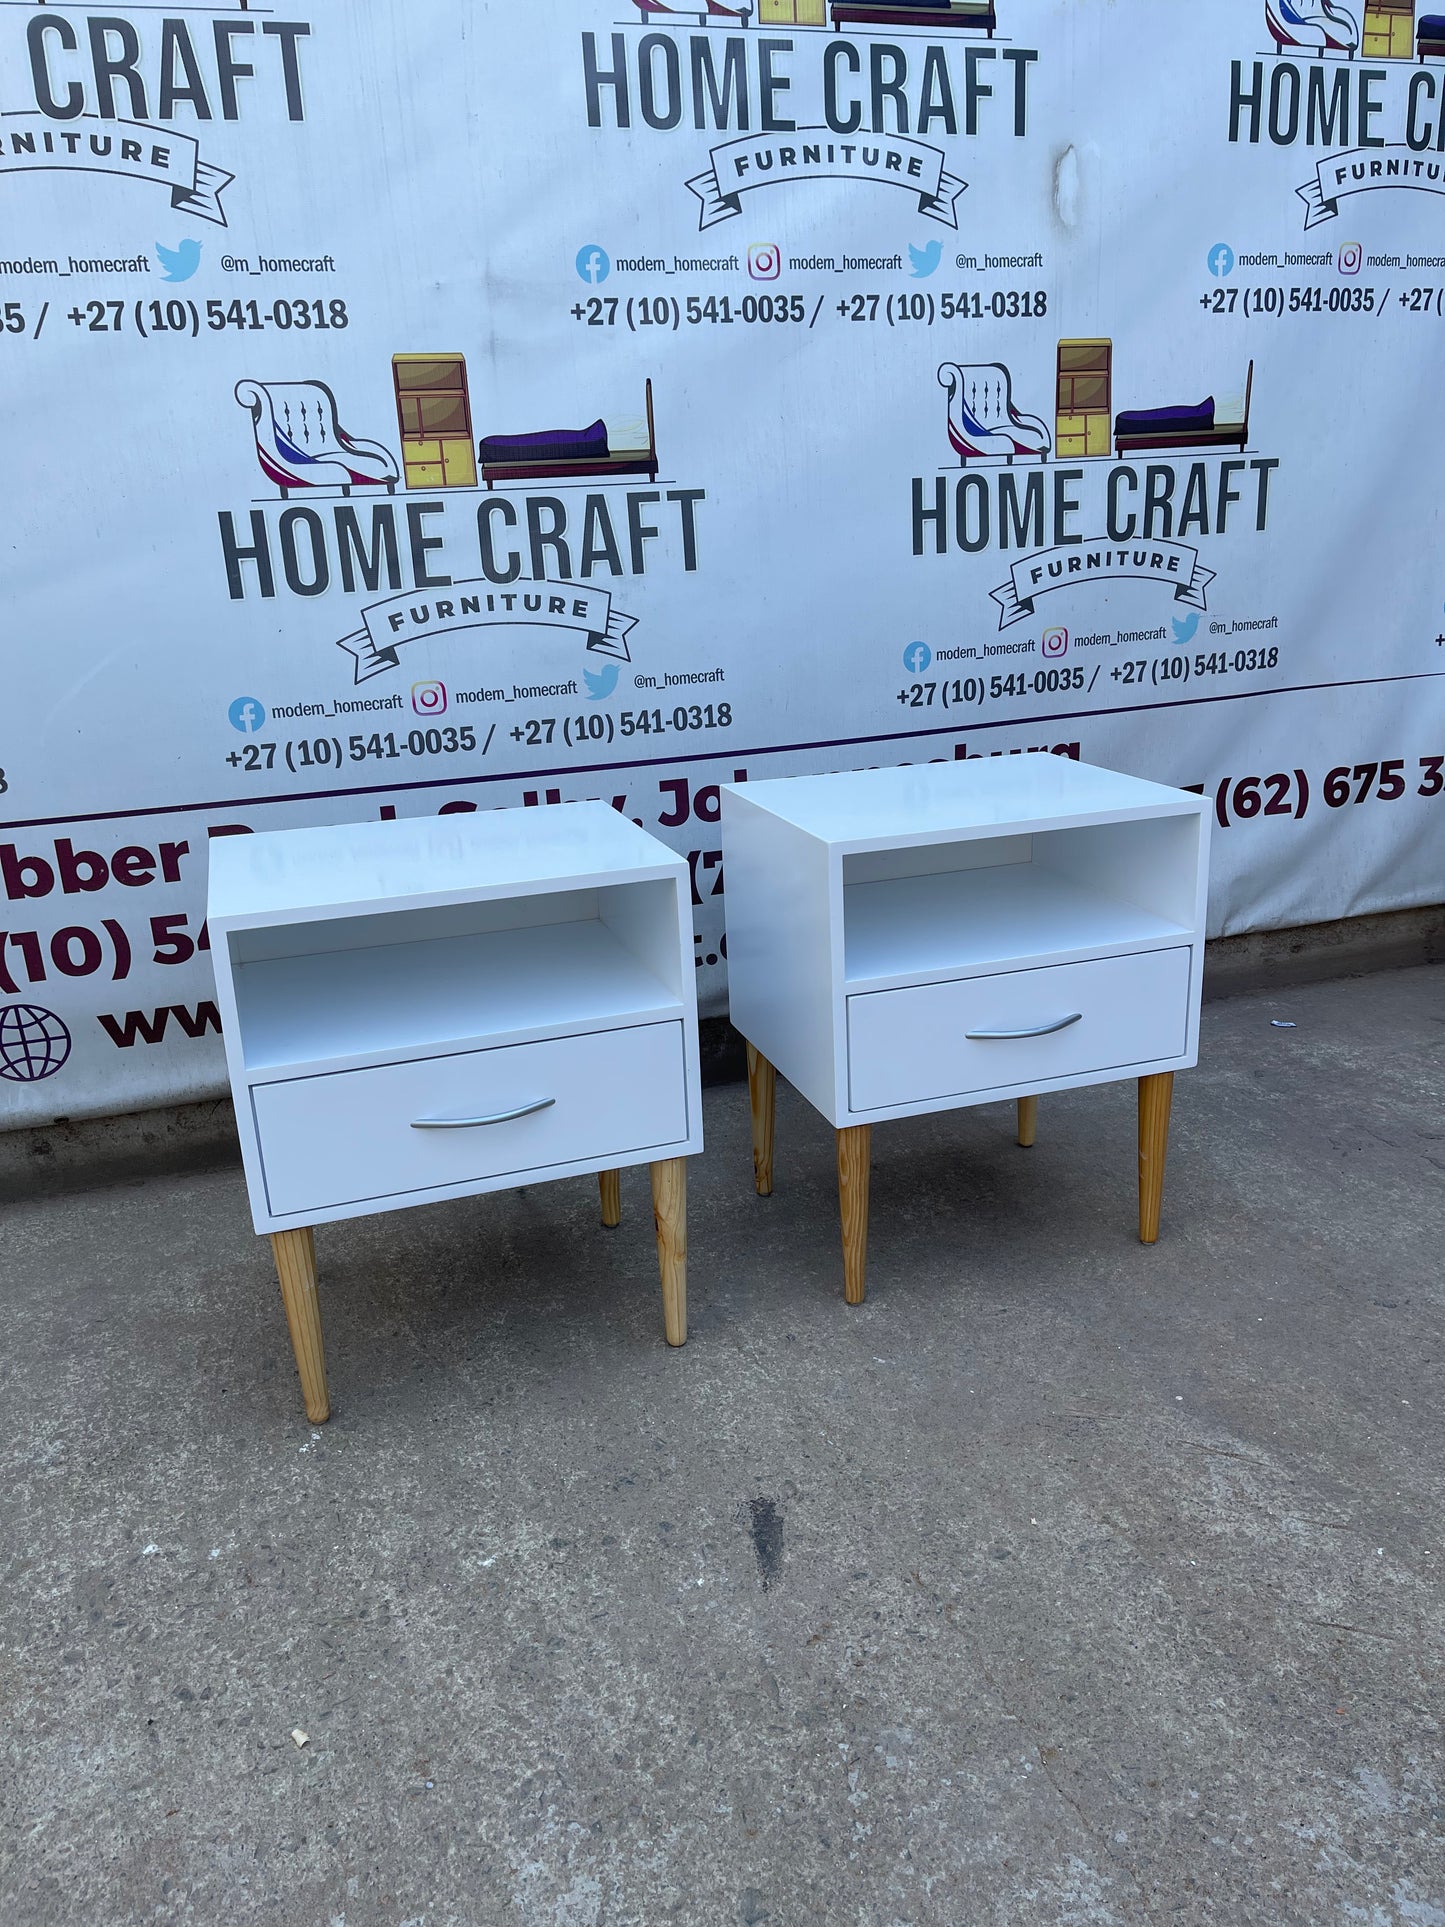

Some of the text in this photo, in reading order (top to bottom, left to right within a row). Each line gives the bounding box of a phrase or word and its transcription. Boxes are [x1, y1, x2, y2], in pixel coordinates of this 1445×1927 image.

[26, 13, 311, 122] CRAFT
[581, 31, 1039, 137] HOME CRAFT
[1227, 59, 1387, 149] HOME
[733, 144, 924, 178] FURNITURE
[220, 254, 337, 276] @m_homecraft
[615, 251, 1044, 275] modern_homecraft modern_homecraft @m_homecraft
[1238, 251, 1334, 269] modern_homecraft
[66, 300, 125, 332] +27
[134, 299, 200, 339] (10)
[205, 298, 349, 331] 541-0318
[570, 296, 619, 326] +27
[626, 296, 680, 332] (10)
[686, 294, 806, 325] 541-0035
[835, 293, 881, 323] +27
[886, 293, 935, 327] (10)
[940, 290, 1048, 320] 541-0318
[1199, 288, 1239, 314] +27
[1243, 287, 1285, 319] (10)
[1288, 286, 1375, 313] 541-0035
[1398, 287, 1434, 312] +27
[911, 457, 1280, 556] HOME CRAFT
[217, 488, 706, 600] HOME CRAFT
[1029, 550, 1181, 585] FURNITURE
[387, 593, 589, 633] FURNITURE
[936, 615, 1279, 662] modern_homecraft modern_homecraft @m_homecraft
[271, 667, 726, 719] modern_homecraft modern_homecraft @m_homecraft
[896, 681, 937, 708] +27
[941, 677, 986, 710] (10)
[989, 666, 1085, 699] 541-0035
[1109, 659, 1148, 685] +27
[1151, 655, 1190, 686] (10)
[1193, 646, 1279, 677] 541-0318
[225, 742, 277, 772] +27
[285, 737, 343, 774] (10)
[348, 725, 477, 762] 541-0035
[509, 718, 557, 746] +27
[563, 713, 615, 748] (10)
[619, 702, 733, 737] 541-0318
[1215, 768, 1310, 829] (62)
[1322, 758, 1406, 809] 675
